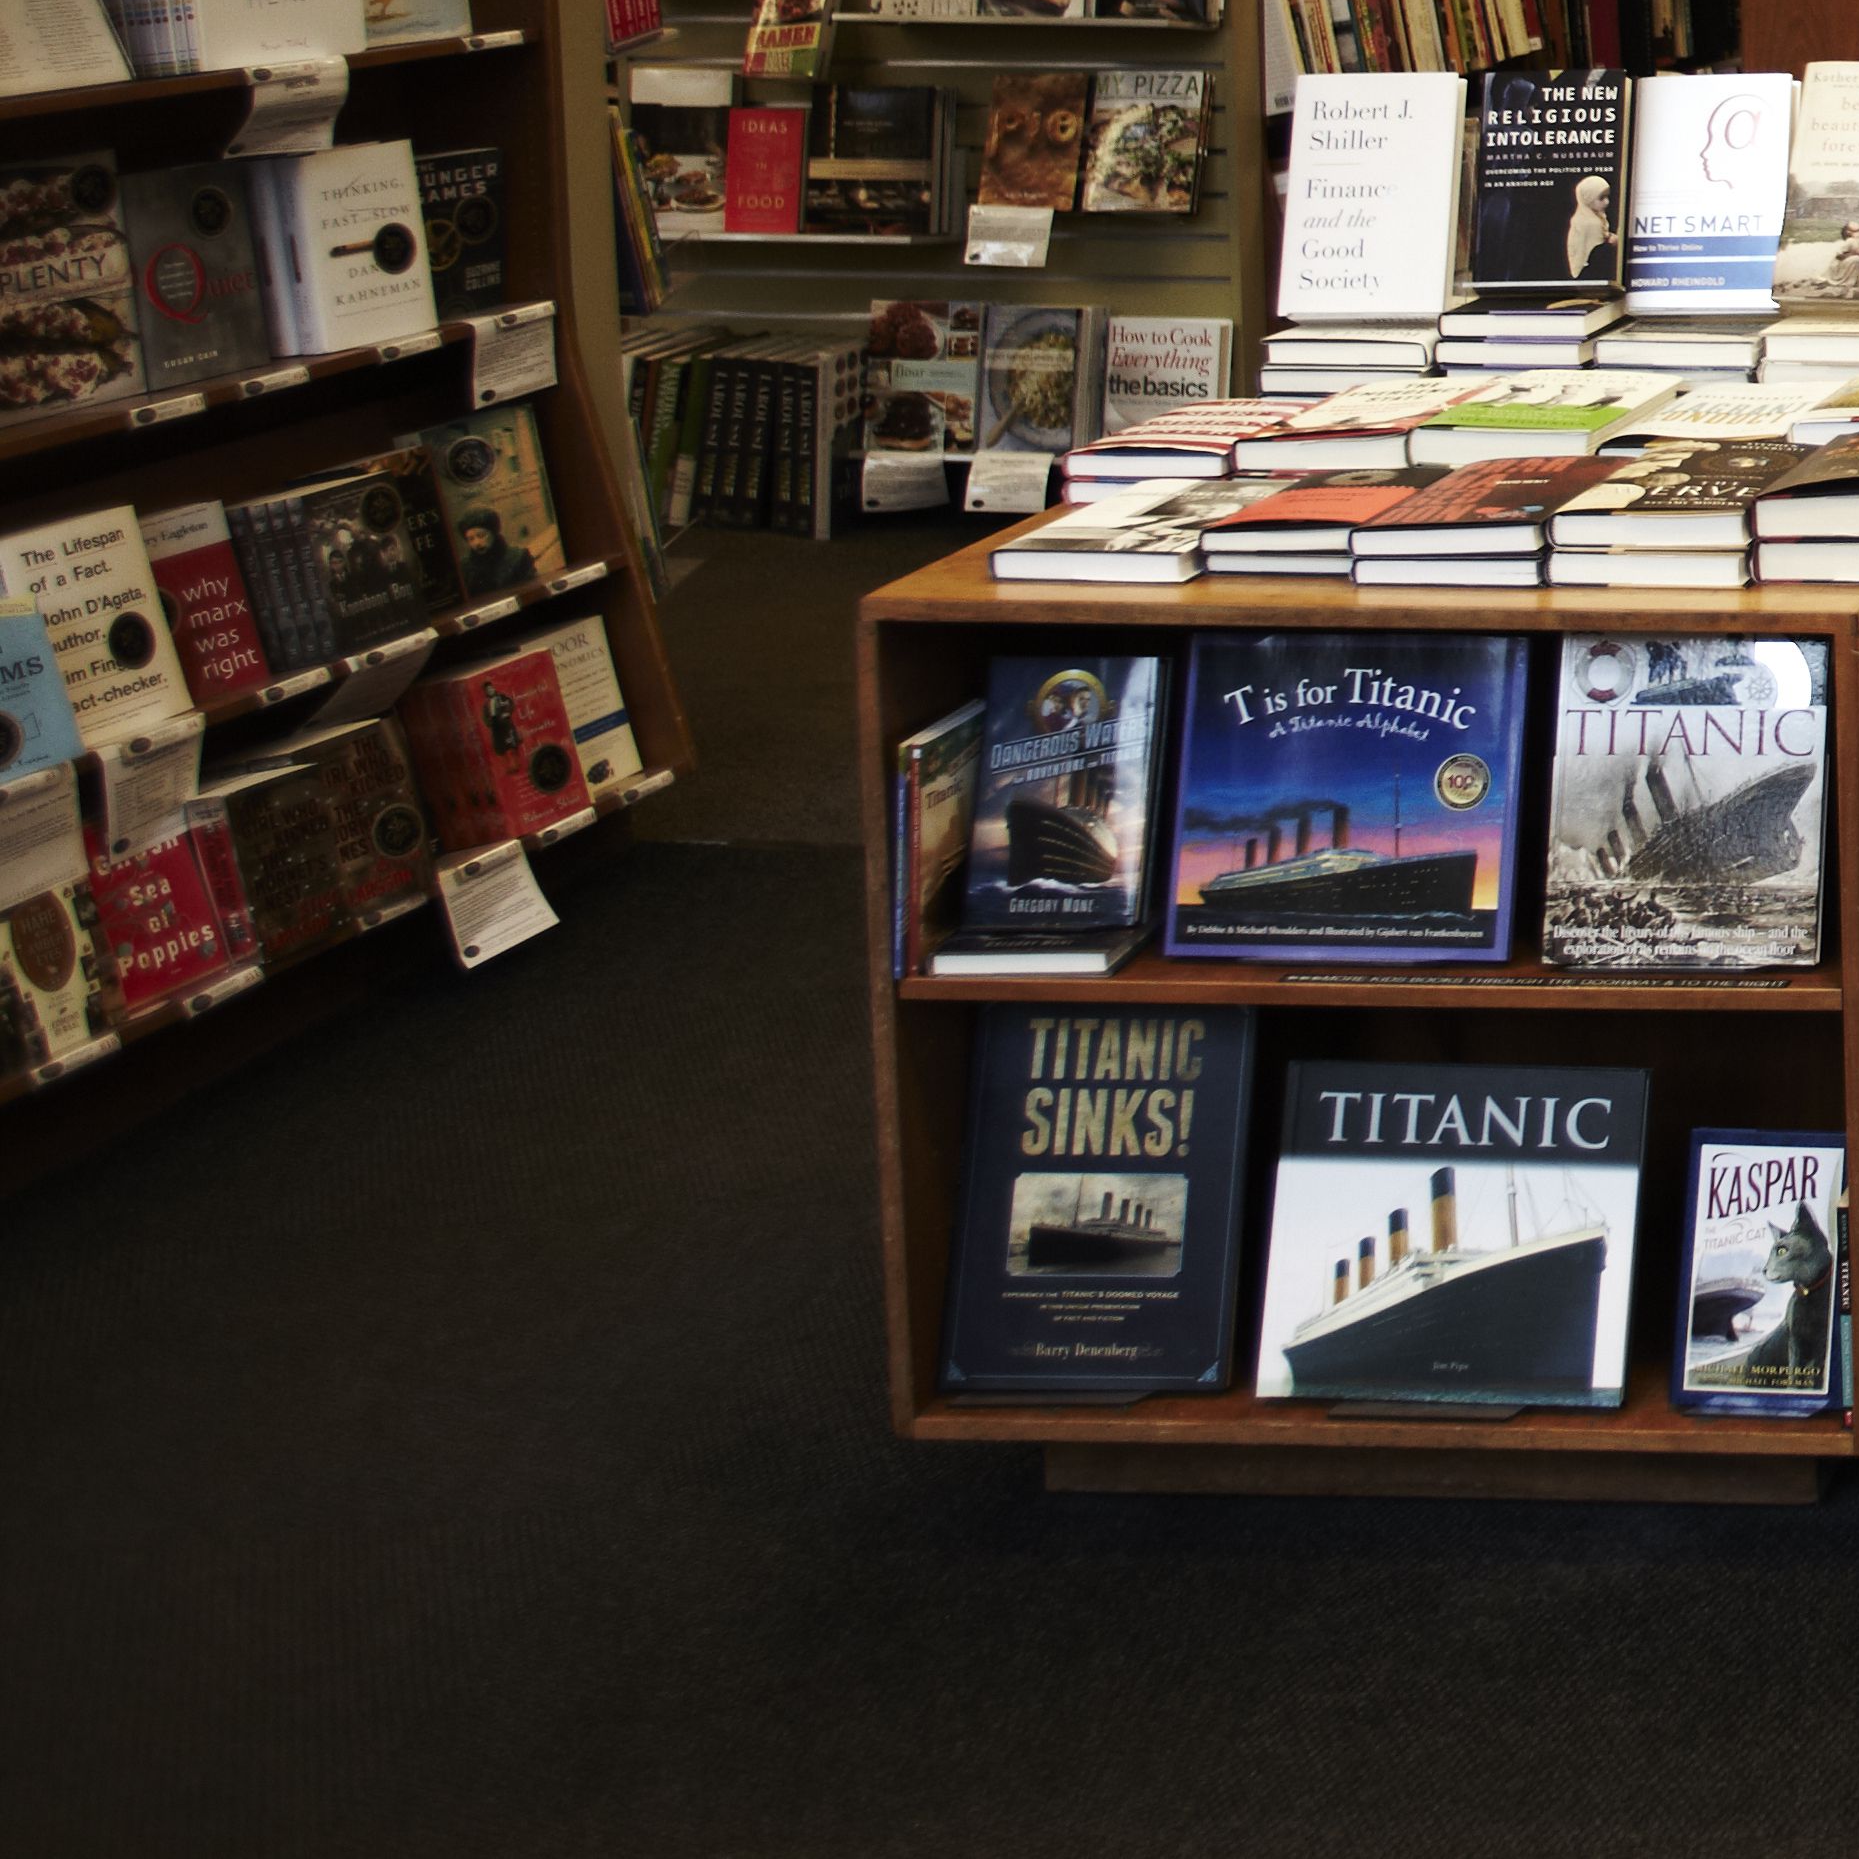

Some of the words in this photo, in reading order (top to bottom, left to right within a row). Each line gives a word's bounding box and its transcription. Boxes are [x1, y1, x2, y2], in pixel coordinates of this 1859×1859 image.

[1542, 87, 1575, 103] THE
[1581, 86, 1618, 102] NEW
[1312, 100, 1386, 121] Robert
[1397, 100, 1413, 120] J.
[1488, 106, 1617, 126] RELIGIOUS
[1309, 130, 1388, 150] Shiller
[1487, 129, 1615, 146] INTOLERANCE
[1111, 325, 1144, 347] How
[1148, 331, 1163, 346] to
[1168, 329, 1211, 348] Cook
[1110, 348, 1210, 376] Everything
[1110, 376, 1138, 396] the
[1141, 376, 1208, 398] basics
[181, 576, 230, 603] why
[189, 598, 249, 629] marx
[196, 628, 241, 653] was
[202, 647, 260, 680] right
[1224, 685, 1255, 725] T
[1263, 687, 1289, 713] is
[1295, 675, 1339, 708] for
[1344, 667, 1476, 732] Titanic
[1565, 708, 1817, 758] TITANIC
[1029, 1017, 1204, 1081] TITANIC
[1022, 1087, 1191, 1158] SINKS!
[1320, 1090, 1613, 1151] TITANIC
[1706, 1154, 1819, 1220] KASPAR
